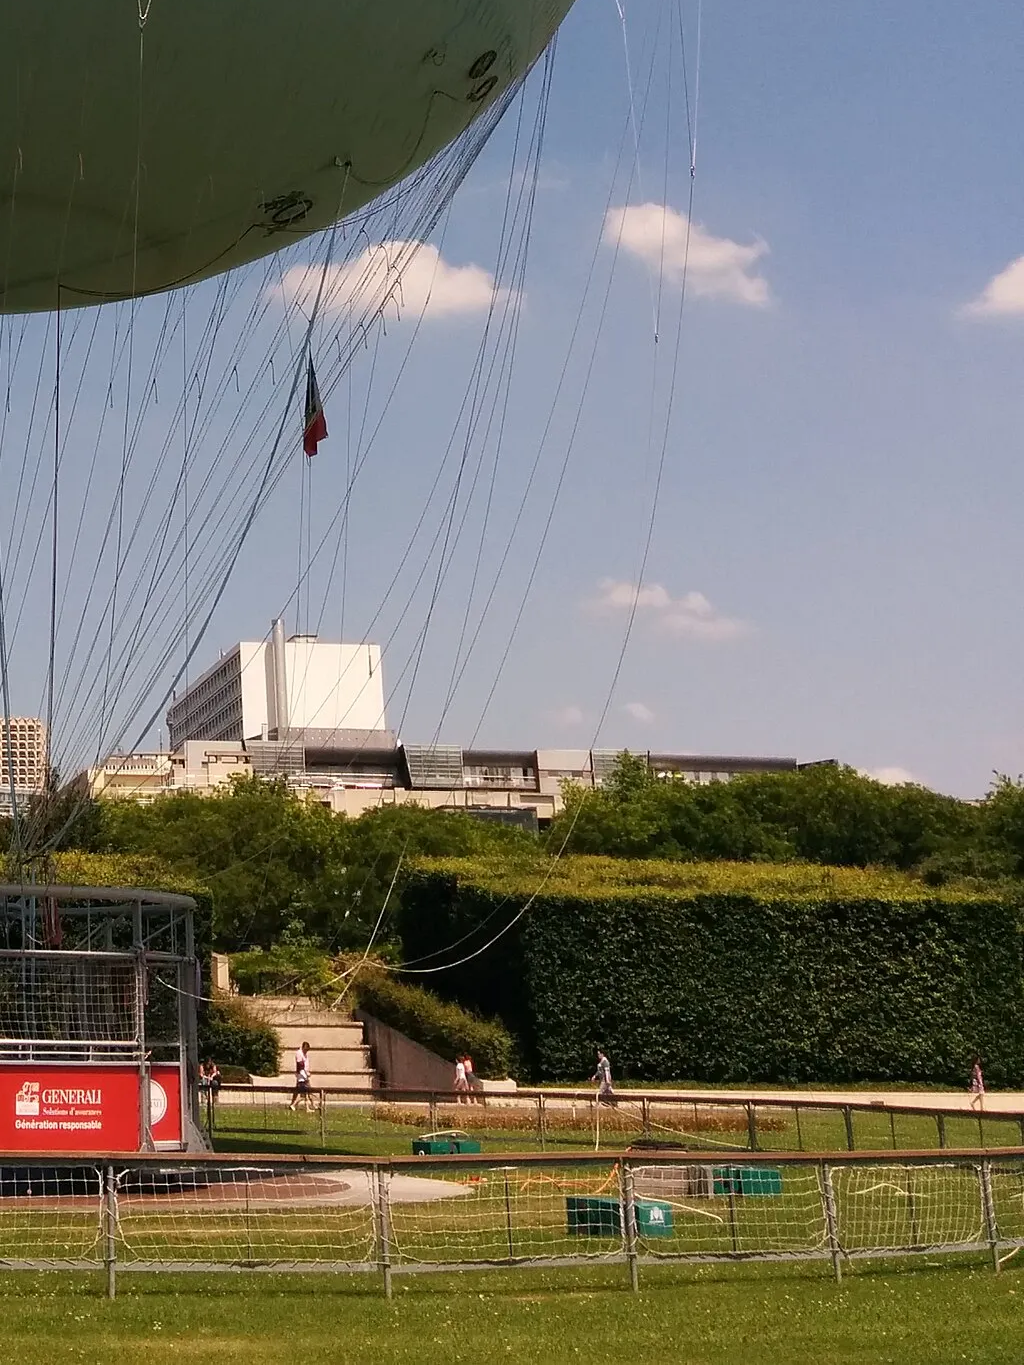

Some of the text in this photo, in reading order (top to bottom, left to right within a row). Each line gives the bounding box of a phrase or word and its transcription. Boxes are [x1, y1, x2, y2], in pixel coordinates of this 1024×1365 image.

[41, 1089, 102, 1104] GENERALI
[15, 1119, 102, 1131] Génération responsable
